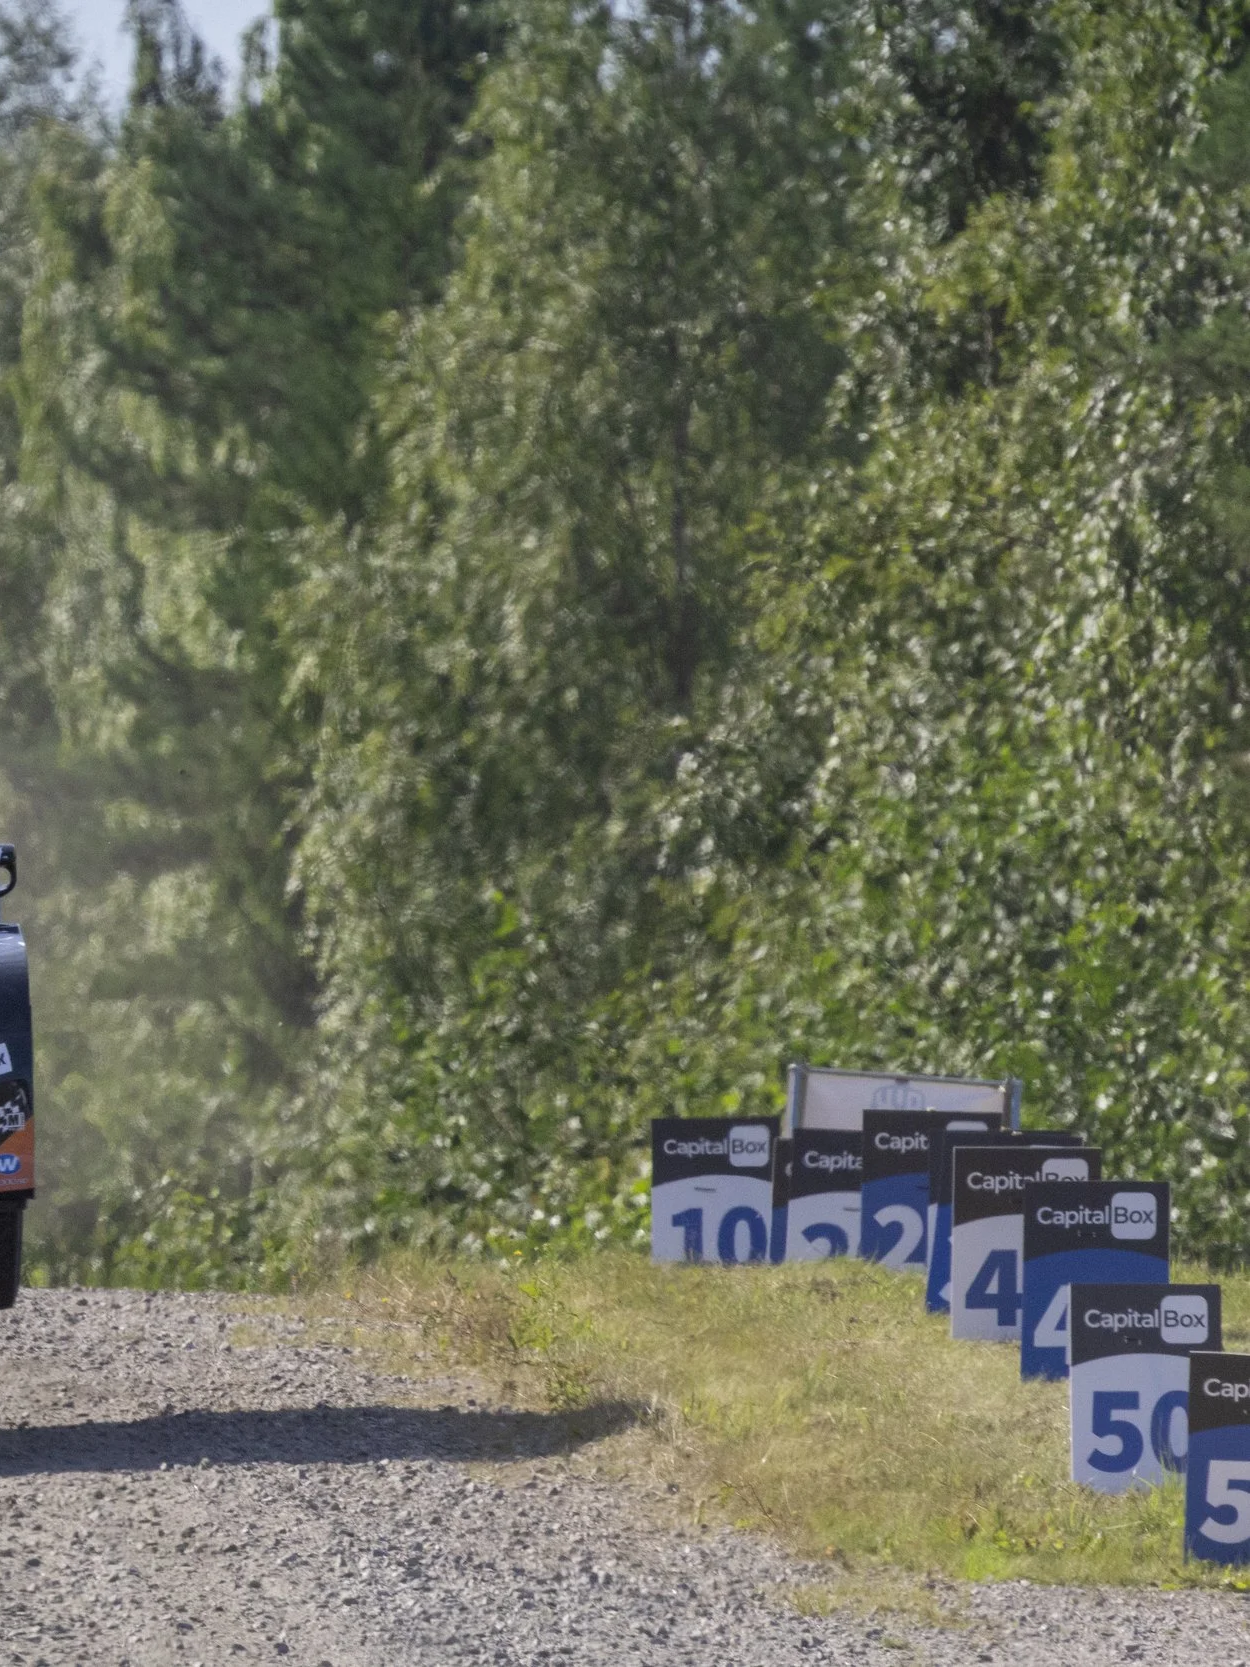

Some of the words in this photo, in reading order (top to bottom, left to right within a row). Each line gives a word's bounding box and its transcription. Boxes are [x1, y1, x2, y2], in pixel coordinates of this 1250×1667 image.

[671, 1206, 768, 1265] 10
[964, 1249, 1023, 1326] 4
[1087, 1390, 1189, 1473] 50
[1200, 1460, 1250, 1544] 5
